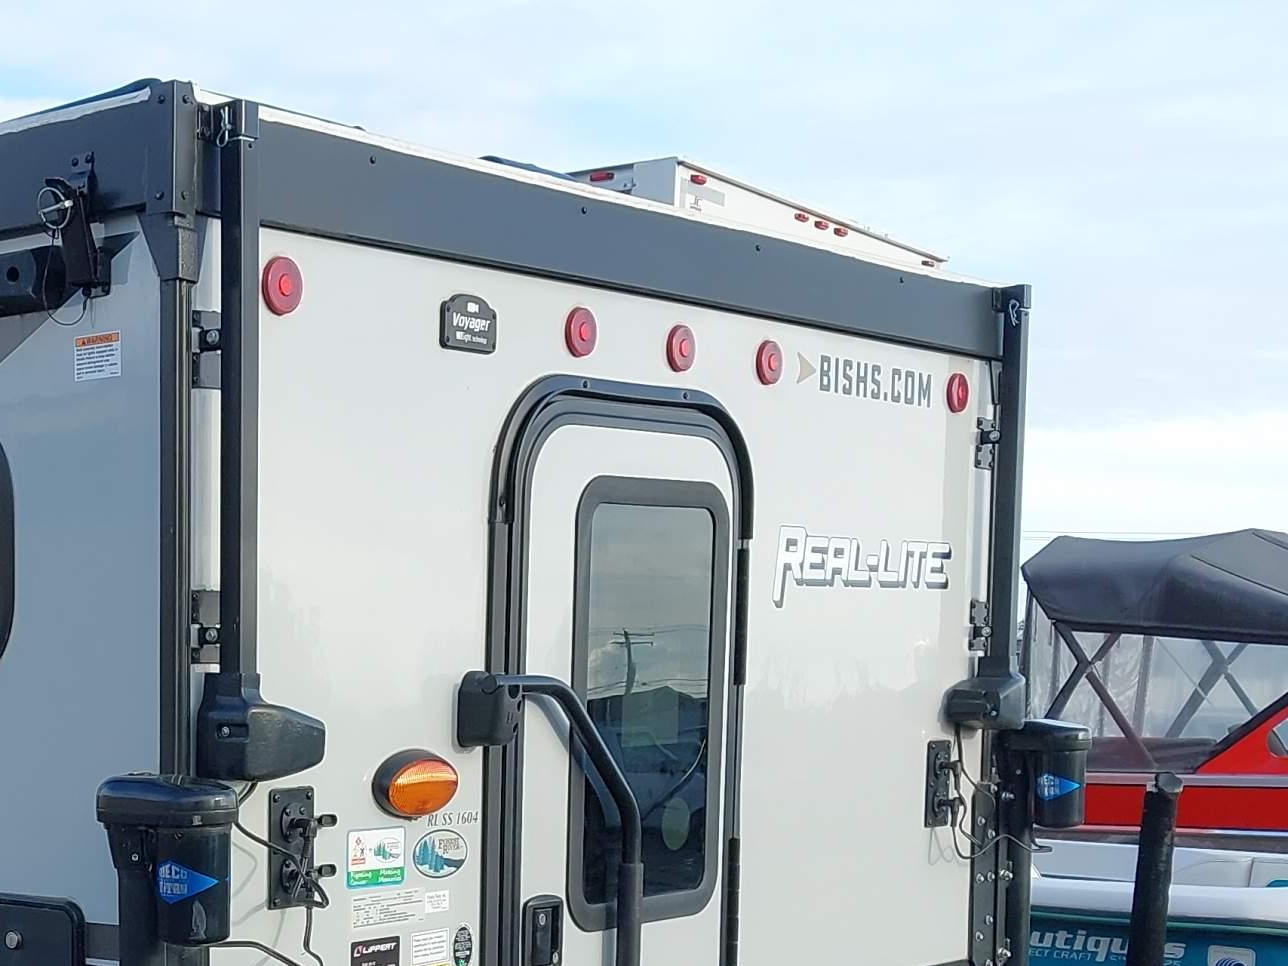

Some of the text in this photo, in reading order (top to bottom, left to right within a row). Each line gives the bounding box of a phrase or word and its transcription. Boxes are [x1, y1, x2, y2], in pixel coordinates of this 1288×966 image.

[452, 311, 490, 332] Voyager
[819, 354, 932, 408] BISHS.COM
[772, 524, 952, 609] REAL-LITE
[427, 811, 479, 827] RL SS 1604
[363, 942, 397, 954] LIPPERT
[1029, 929, 1187, 962] utiqus
[1053, 950, 1091, 961] CRAFT
